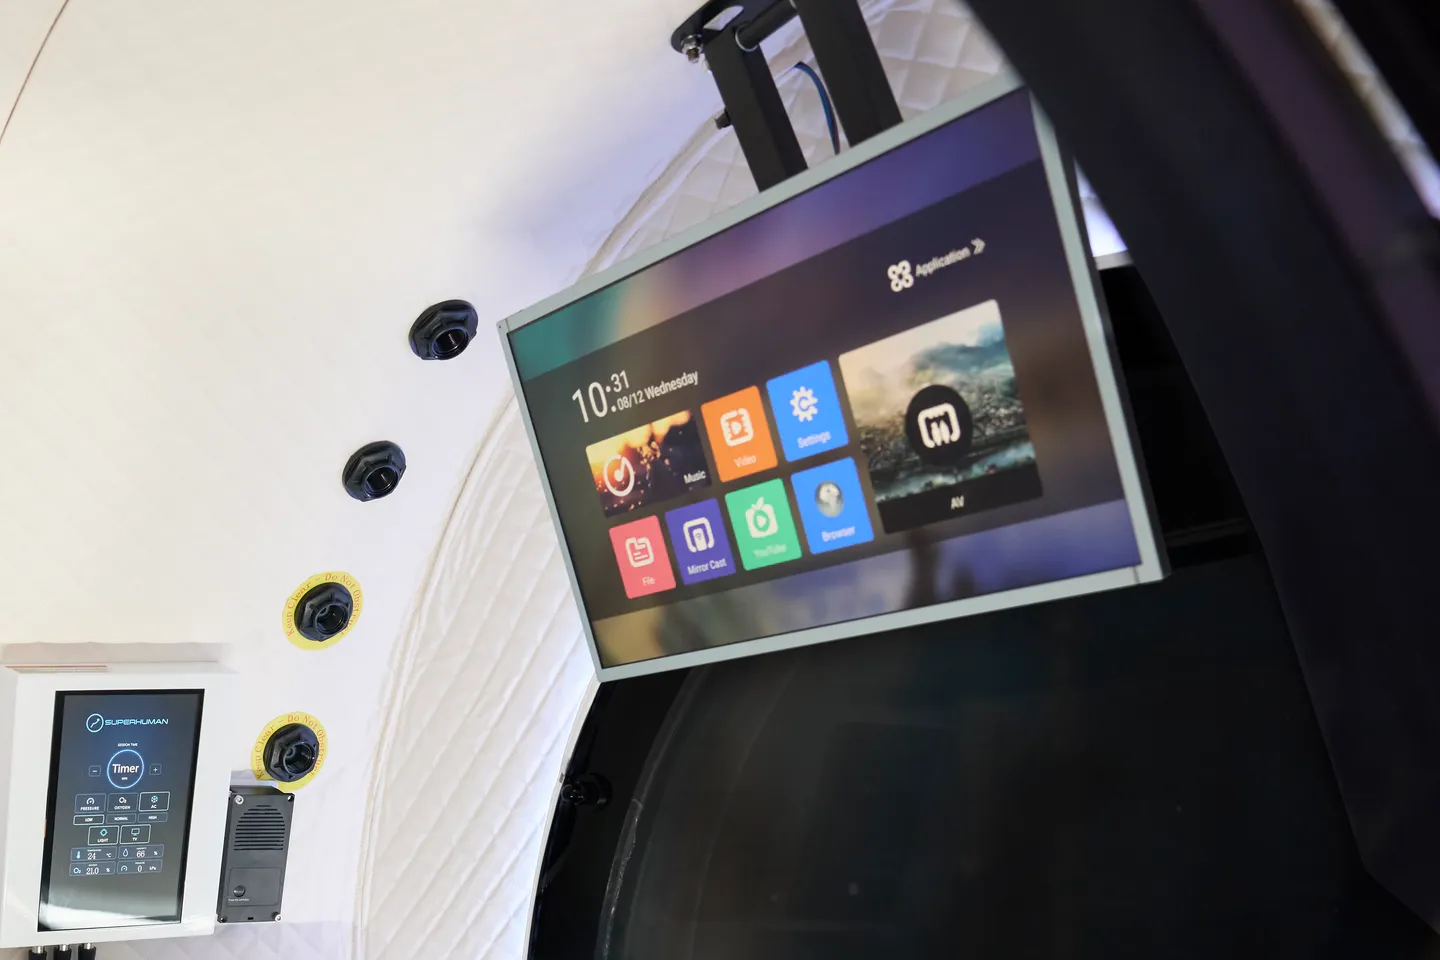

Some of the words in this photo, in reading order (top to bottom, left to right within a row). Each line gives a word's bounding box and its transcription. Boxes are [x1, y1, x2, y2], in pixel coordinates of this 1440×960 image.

[915, 247, 971, 277] Application
[617, 391, 645, 411] 08/12
[644, 371, 698, 400] Wednesday
[797, 431, 831, 448] Settings
[734, 456, 756, 468] Video
[684, 470, 707, 484] Music
[822, 526, 855, 542] Browser
[687, 561, 709, 575] Mirror
[709, 558, 728, 571] Cast
[642, 576, 656, 586] File
[288, 582, 312, 610] Clear
[324, 573, 338, 581] Do
[340, 574, 357, 590] Not
[104, 718, 169, 726] SUPERHUMAN
[255, 724, 275, 753] Clear
[287, 714, 300, 722] Do
[303, 714, 318, 729] Not
[112, 763, 140, 774] Timer
[87, 852, 96, 860] 24
[136, 850, 146, 858] 66
[86, 867, 100, 875] 21.0
